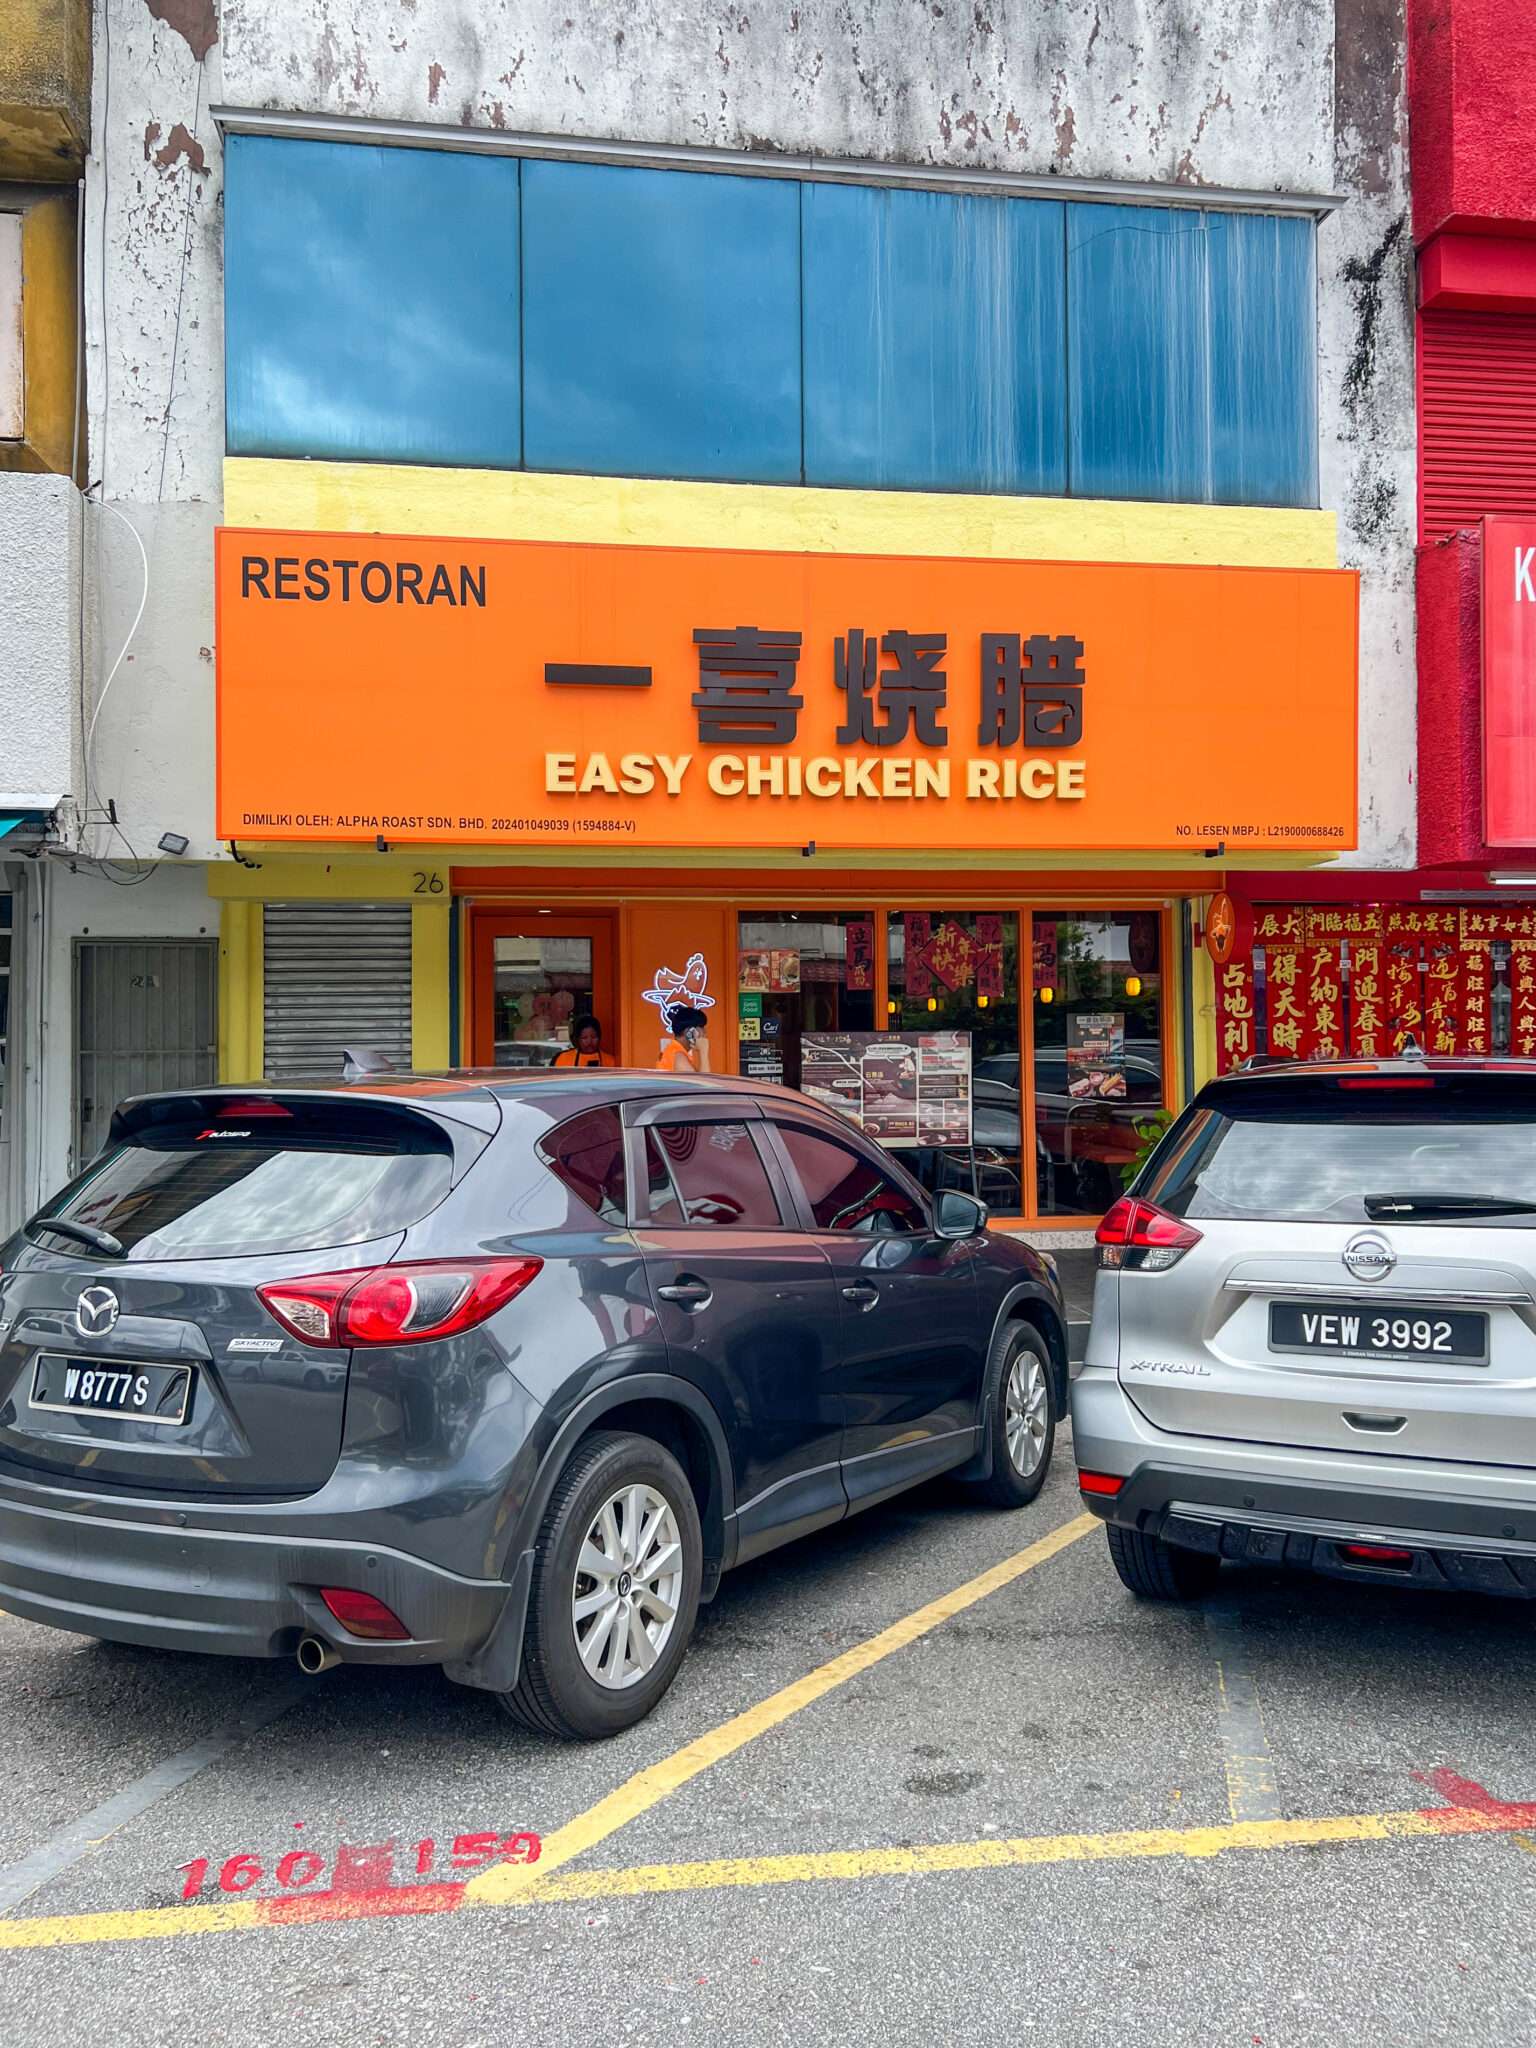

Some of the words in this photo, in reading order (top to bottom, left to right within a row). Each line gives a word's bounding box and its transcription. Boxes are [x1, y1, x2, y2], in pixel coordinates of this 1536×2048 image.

[242, 556, 486, 608] RESTORAN
[544, 626, 1087, 749] 一喜烧腊
[545, 753, 692, 796] EASY
[708, 755, 950, 798] CHICKEN
[967, 759, 1086, 800] RICE
[243, 813, 292, 826] DIMILIKI
[296, 815, 334, 827] OLEH:
[336, 815, 379, 828] ALPHA
[382, 816, 424, 829] ROAST
[427, 817, 456, 829] SDN.
[459, 818, 488, 829] BHD.
[491, 818, 570, 831] 202401049039
[572, 819, 636, 834] (1594884-V)
[1176, 825, 1194, 836] NO.
[1196, 825, 1230, 836] LESEN
[1232, 825, 1260, 836] MBPJ
[1267, 826, 1345, 837] L2190000688426
[413, 872, 444, 894] 26
[1468, 914, 1534, 934] 萬事如意
[1347, 1254, 1391, 1264] NISSAN
[1301, 1312, 1361, 1346] VEW
[1371, 1318, 1453, 1352] 3992
[1129, 1360, 1212, 1377] X-TRAIL
[178, 1850, 325, 1900] 160
[414, 1831, 542, 1874] 159
